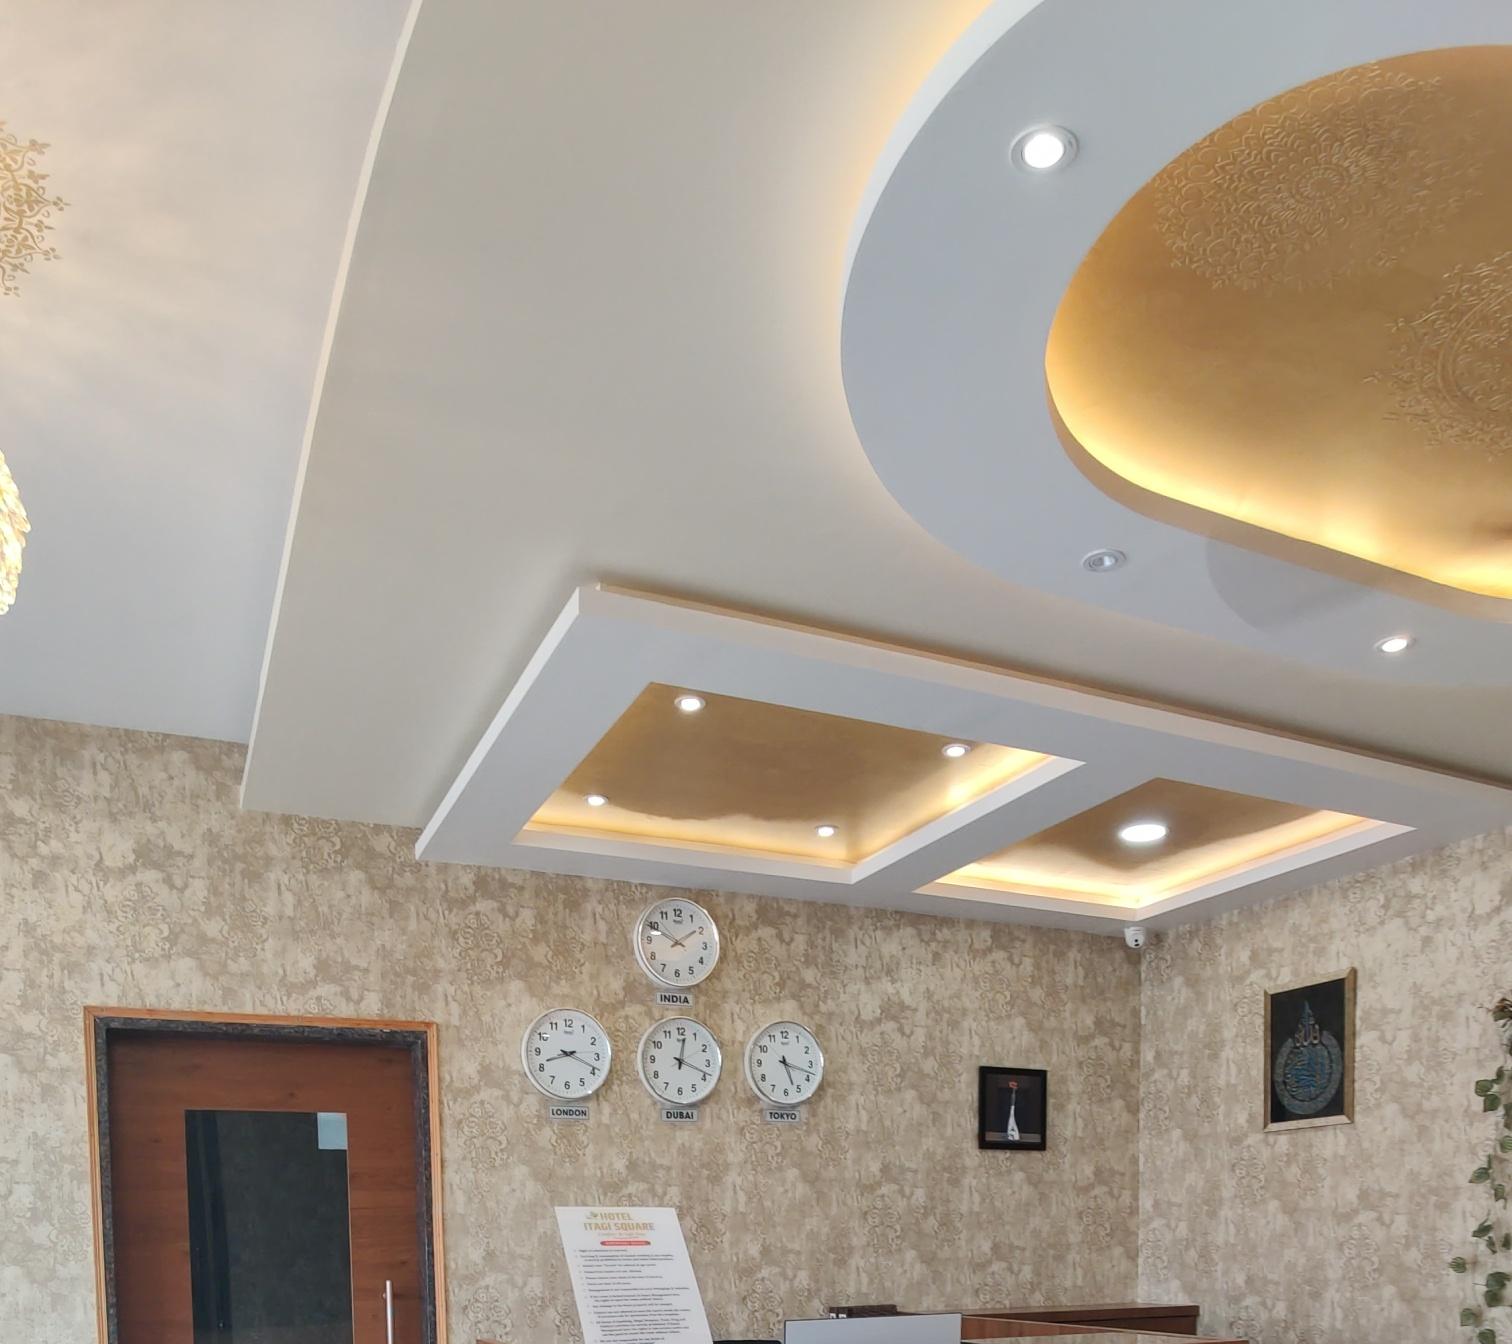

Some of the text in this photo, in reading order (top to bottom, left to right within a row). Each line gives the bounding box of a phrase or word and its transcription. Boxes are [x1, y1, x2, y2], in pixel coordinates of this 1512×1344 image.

[660, 911, 668, 920] 11
[673, 909, 682, 918] 12
[690, 915, 693, 923] 1
[699, 927, 704, 935] 2
[647, 936, 652, 944] 9
[650, 952, 655, 960] 8
[699, 956, 704, 965] 4
[660, 964, 666, 972] 7
[675, 969, 680, 977] 6
[660, 994, 689, 1004] INDIA
[550, 1022, 558, 1030] 11
[564, 1019, 573, 1028] 12
[581, 1025, 585, 1033] 1
[677, 1028, 685, 1036] 12
[663, 1031, 671, 1039] 11
[780, 1031, 789, 1039] 12
[591, 1037, 596, 1046] 2
[652, 1041, 662, 1049] 10
[535, 1047, 541, 1056] 9
[594, 1053, 600, 1061] 3
[705, 1059, 710, 1068] 3
[757, 1059, 762, 1067] 9
[539, 1063, 544, 1072] 8
[590, 1067, 595, 1076] 4
[654, 1071, 659, 1079] 8
[701, 1073, 706, 1082] 4
[761, 1074, 766, 1082] 8
[550, 1076, 555, 1084] 7
[580, 1078, 585, 1086] 5
[564, 1081, 570, 1089] 6
[664, 1082, 669, 1090] 7
[692, 1084, 696, 1092] 5
[600, 1212, 633, 1221] HOTEL
[615, 1223, 655, 1231] SQUARE
